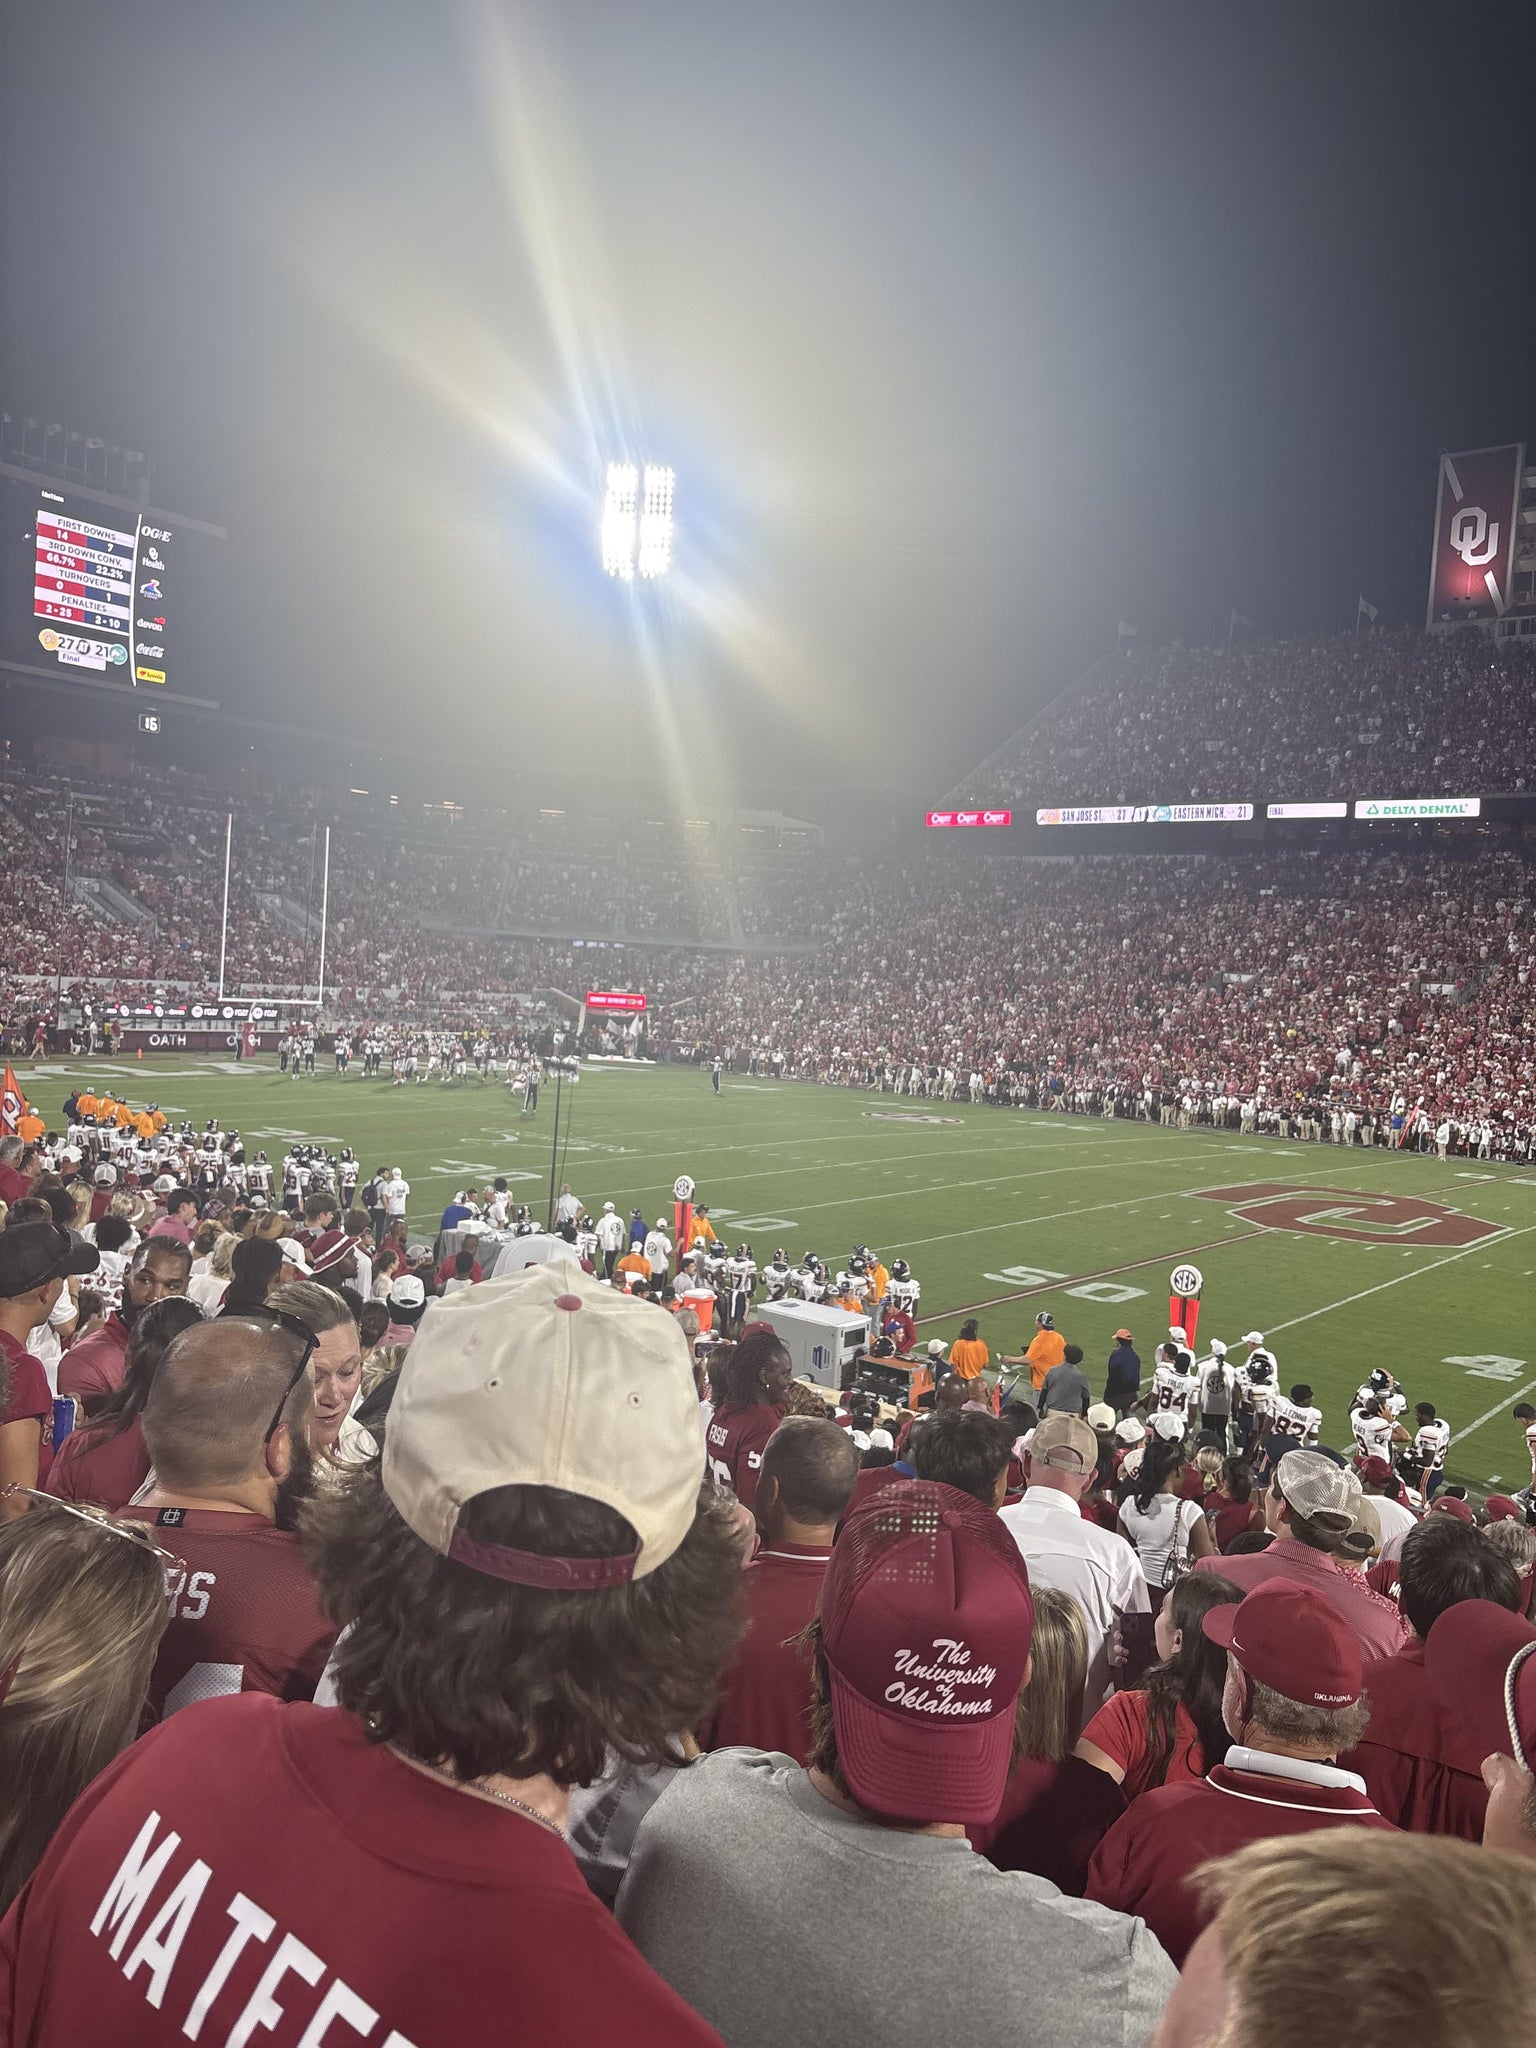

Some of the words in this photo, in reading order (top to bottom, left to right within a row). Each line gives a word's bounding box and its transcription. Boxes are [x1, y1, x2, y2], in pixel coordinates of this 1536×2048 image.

[56, 529, 69, 540] 14
[57, 518, 81, 531] FIRST
[83, 526, 117, 541] DOWNS
[1450, 506, 1499, 567] OU
[48, 541, 66, 552] 3RD
[68, 547, 96, 560] DOWN
[97, 554, 123, 567] CONV.
[46, 552, 76, 567] 66.7%
[95, 565, 124, 580] 22.2%
[59, 569, 111, 589] TURNOVERS
[55, 580, 64, 590] 0
[106, 592, 112, 602] 1
[61, 595, 107, 613] PENALTIES
[136, 618, 163, 632] devon
[58, 636, 74, 650] 27
[95, 644, 109, 658] 21
[62, 653, 80, 663] Final
[1061, 810, 1075, 822] SAN
[1076, 810, 1092, 821] JOSE
[1117, 808, 1126, 820] 27
[1174, 808, 1204, 819] EASTERN
[1237, 806, 1247, 818] 21
[1269, 808, 1284, 816] FINAL
[1383, 805, 1416, 815] DELTA
[1420, 804, 1465, 814] DENTAL
[149, 1034, 187, 1046] OATH
[117, 1147, 133, 1161] 40
[201, 1159, 218, 1172] 25
[250, 1175, 263, 1188] 31
[1175, 1270, 1197, 1292] SEC
[1160, 1386, 1188, 1413] 84
[932, 1638, 971, 1665] The
[894, 1649, 997, 1689] University
[935, 1681, 955, 1697] of
[1313, 1692, 1353, 1703] OKLAHOMA
[885, 1681, 993, 1715] Oklahoma
